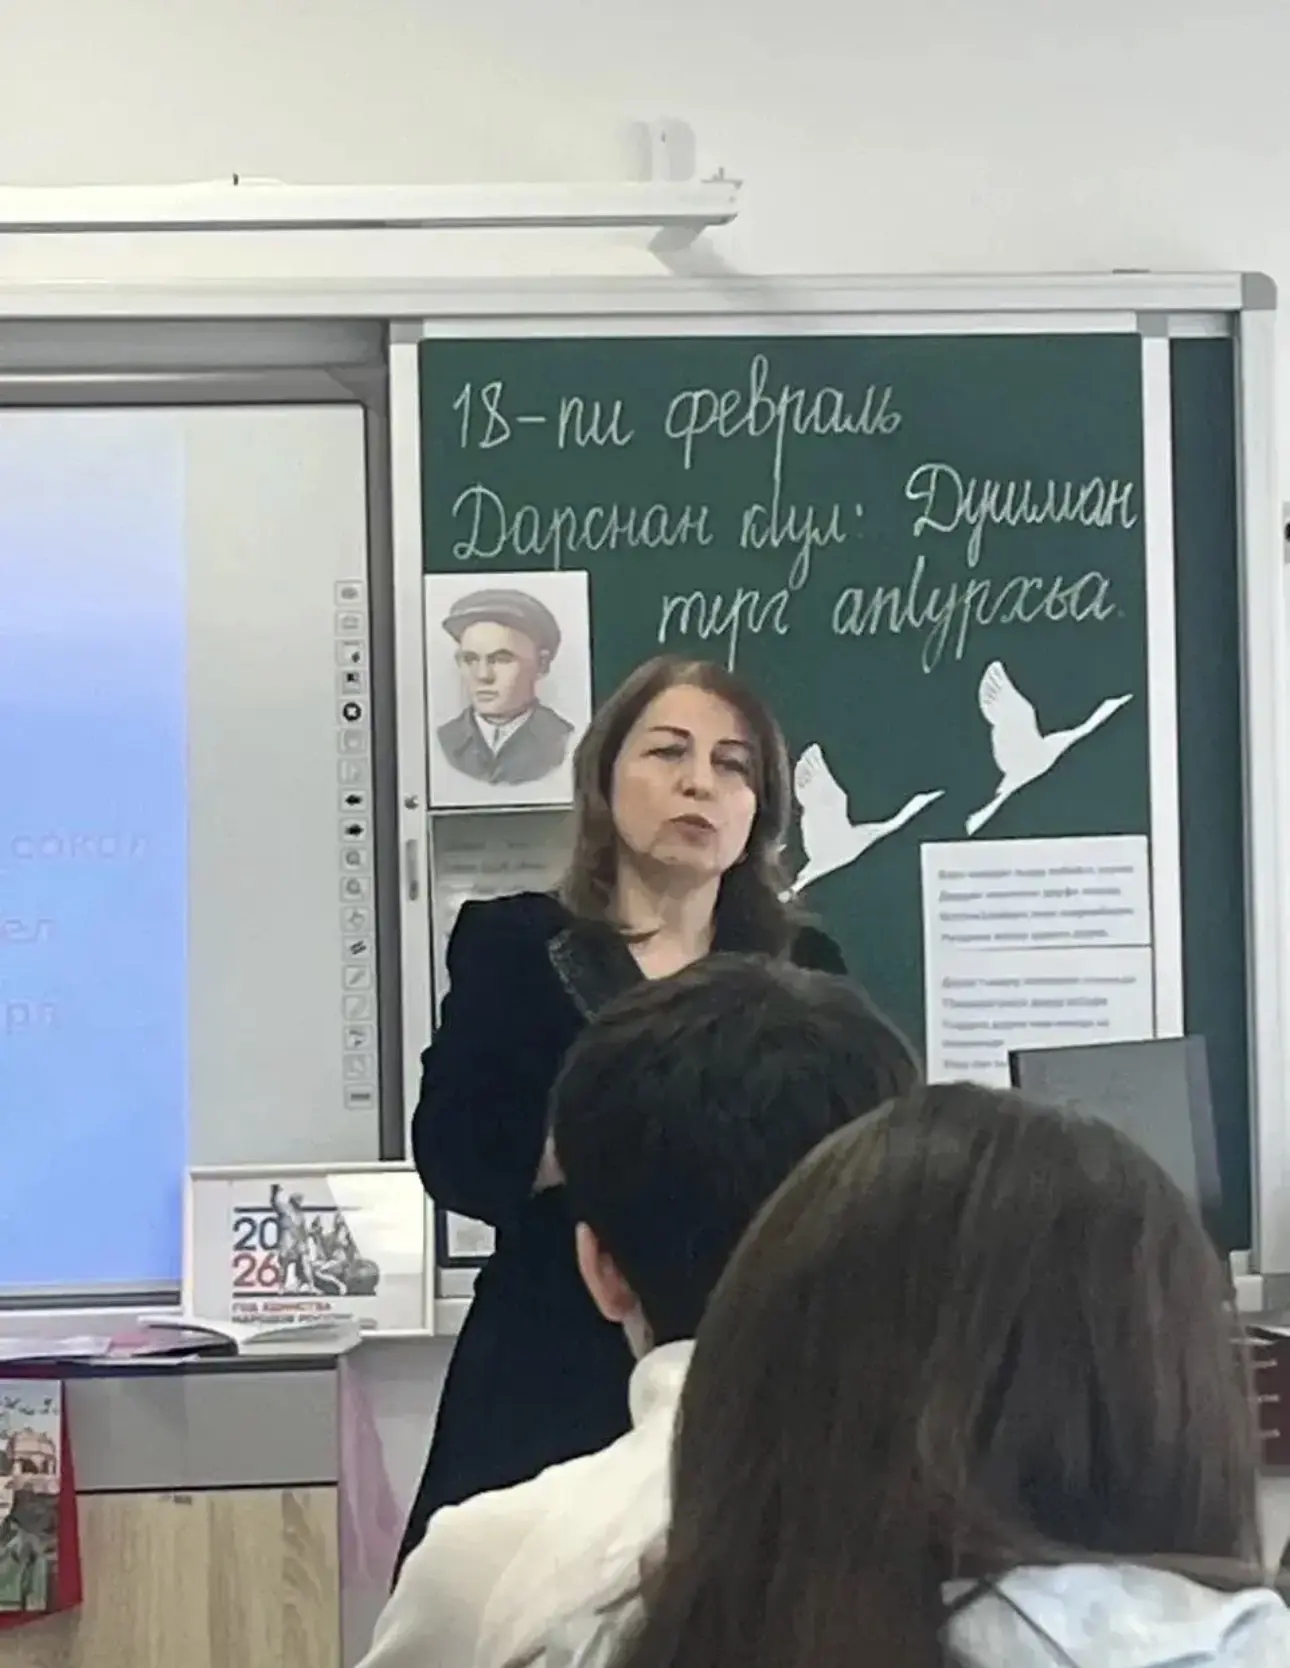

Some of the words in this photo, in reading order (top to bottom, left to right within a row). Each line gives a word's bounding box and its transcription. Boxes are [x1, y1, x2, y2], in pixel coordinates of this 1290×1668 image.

[664, 353, 902, 476] февраль
[452, 481, 714, 570] Дарснан
[905, 462, 1138, 569] Душман
[232, 1216, 280, 1251] 20
[231, 1253, 280, 1288] 26
